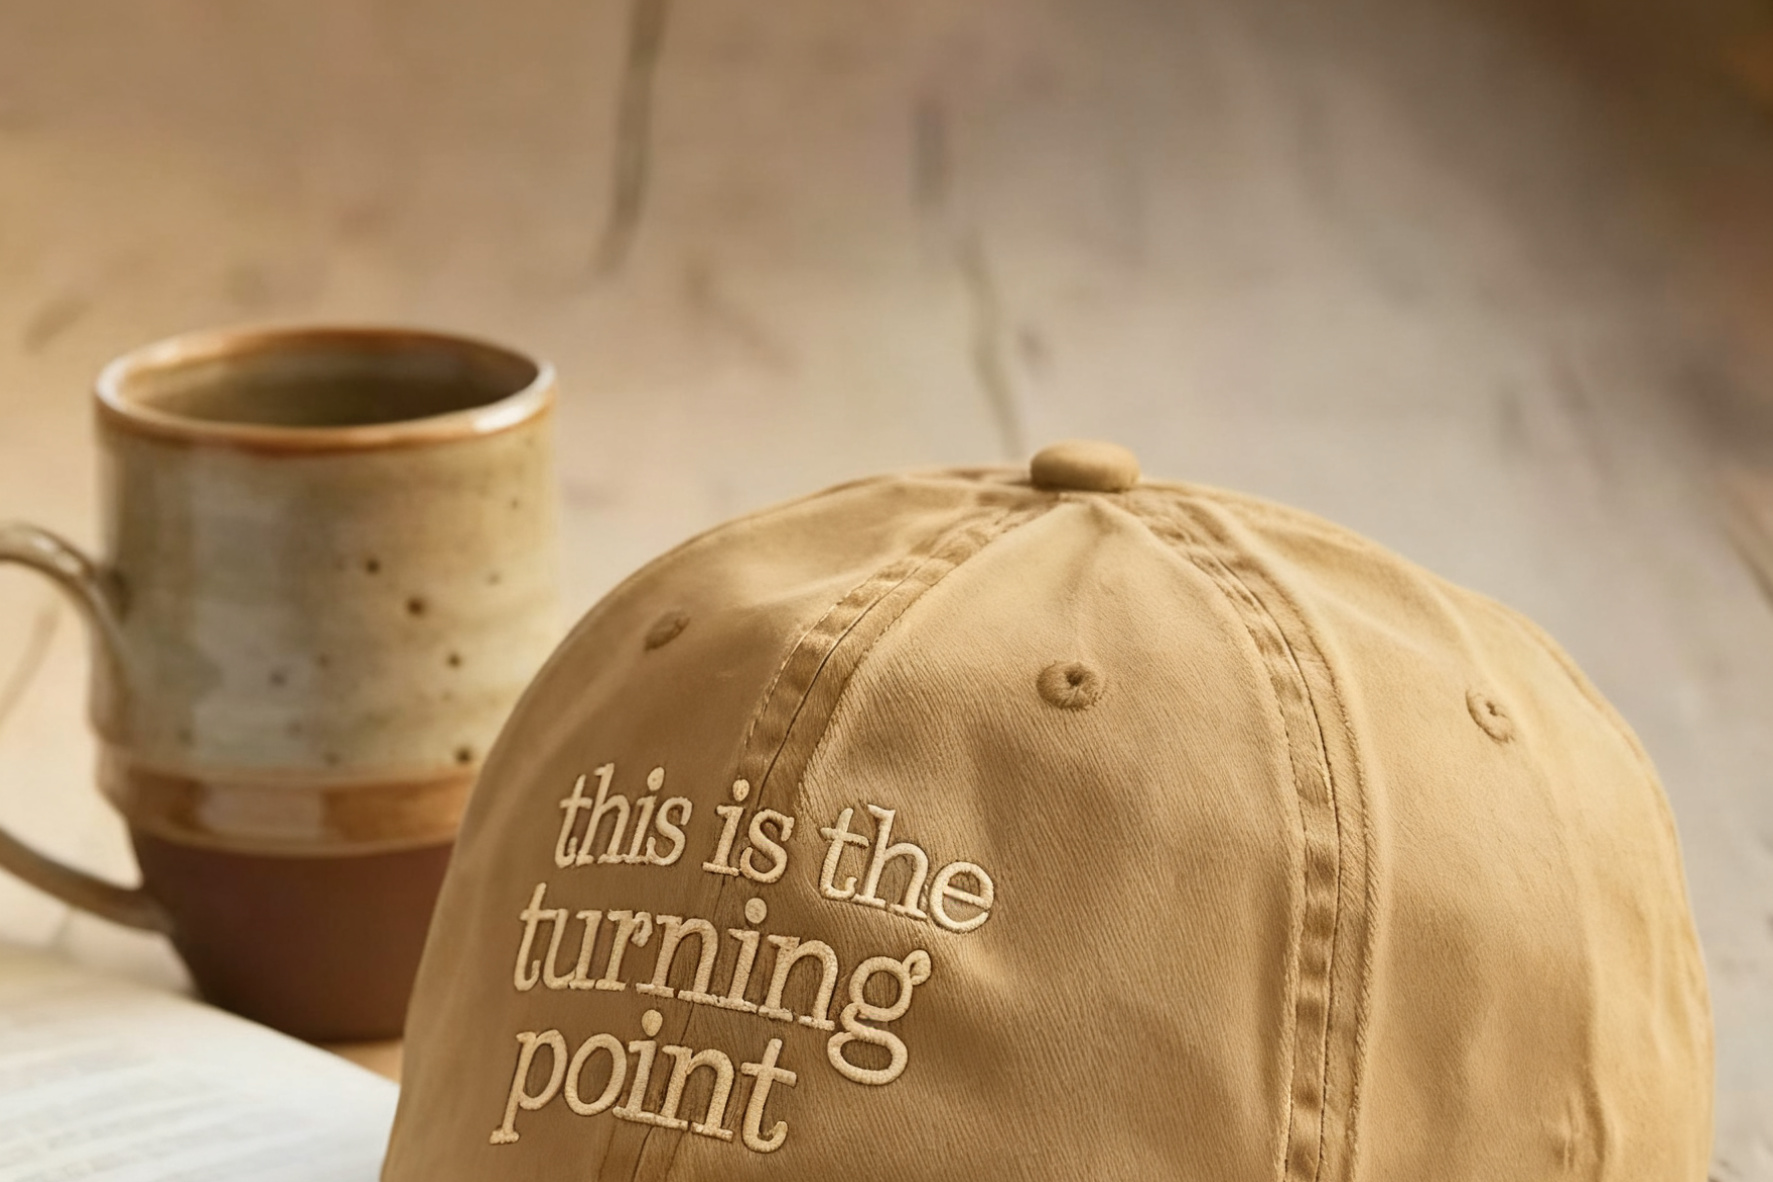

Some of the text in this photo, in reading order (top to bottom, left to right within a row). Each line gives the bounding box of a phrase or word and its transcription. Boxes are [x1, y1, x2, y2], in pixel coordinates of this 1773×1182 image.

[554, 763, 994, 933] this is the
[513, 882, 932, 1086] turning
[490, 1009, 797, 1153] point
